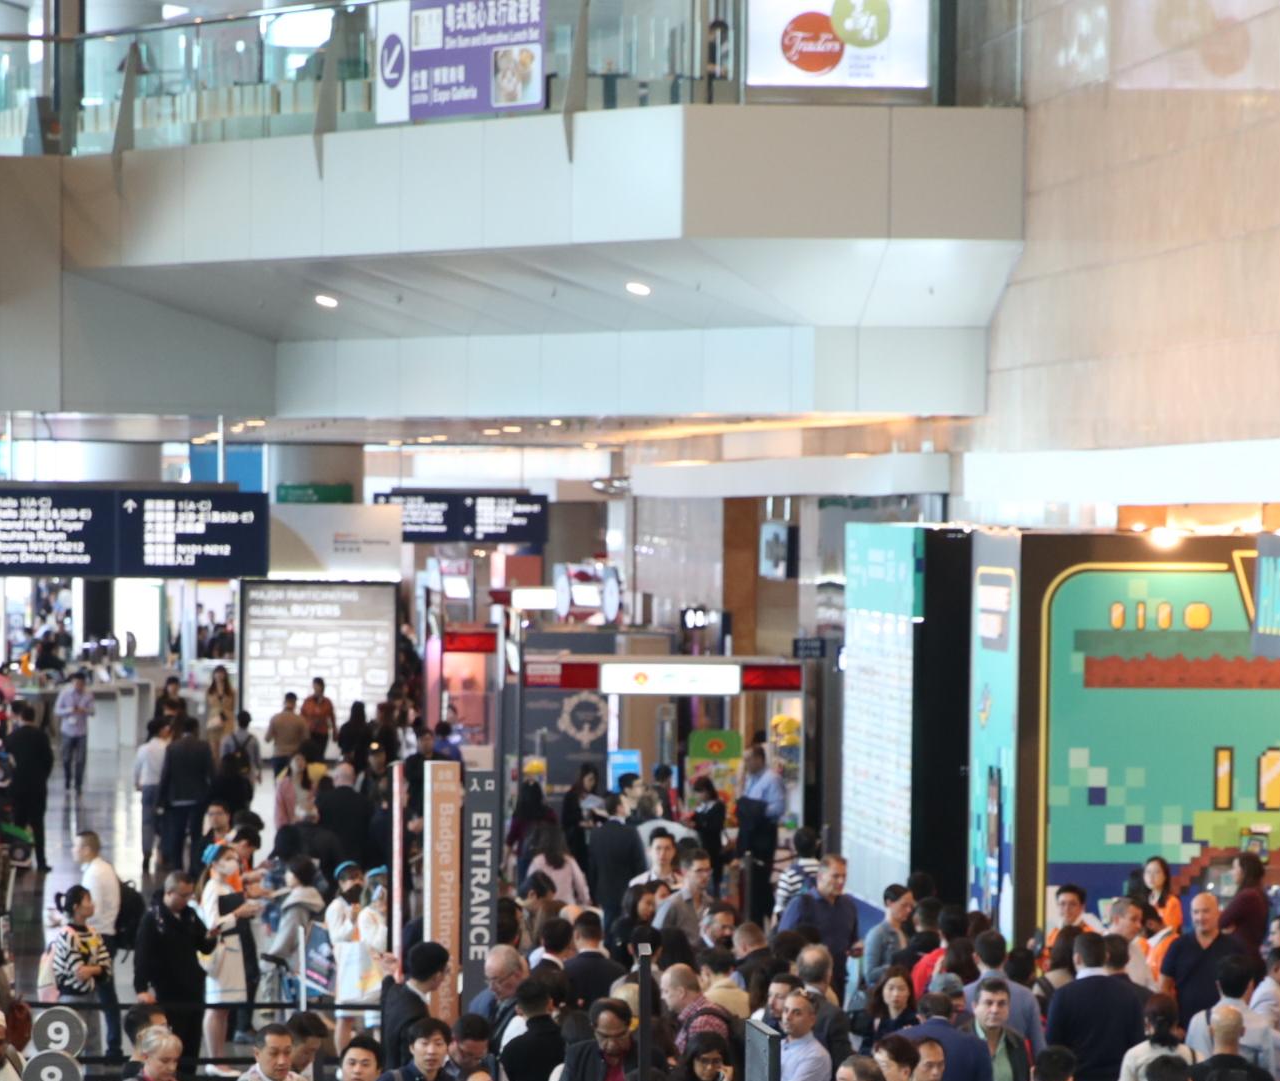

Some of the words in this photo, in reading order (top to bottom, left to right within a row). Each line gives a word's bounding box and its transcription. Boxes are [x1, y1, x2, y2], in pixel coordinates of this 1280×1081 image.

[433, 88, 451, 104] Expo
[25, 520, 46, 530] Hall
[55, 520, 84, 532] Foyer
[36, 531, 67, 541] Room
[19, 552, 46, 563] Drive
[46, 552, 91, 563] Entrance
[290, 603, 341, 618] BUYERS
[470, 778, 495, 792] 入口
[438, 803, 455, 865] Badge
[469, 812, 493, 961] ENTRANCE
[47, 1021, 69, 1053] 9
